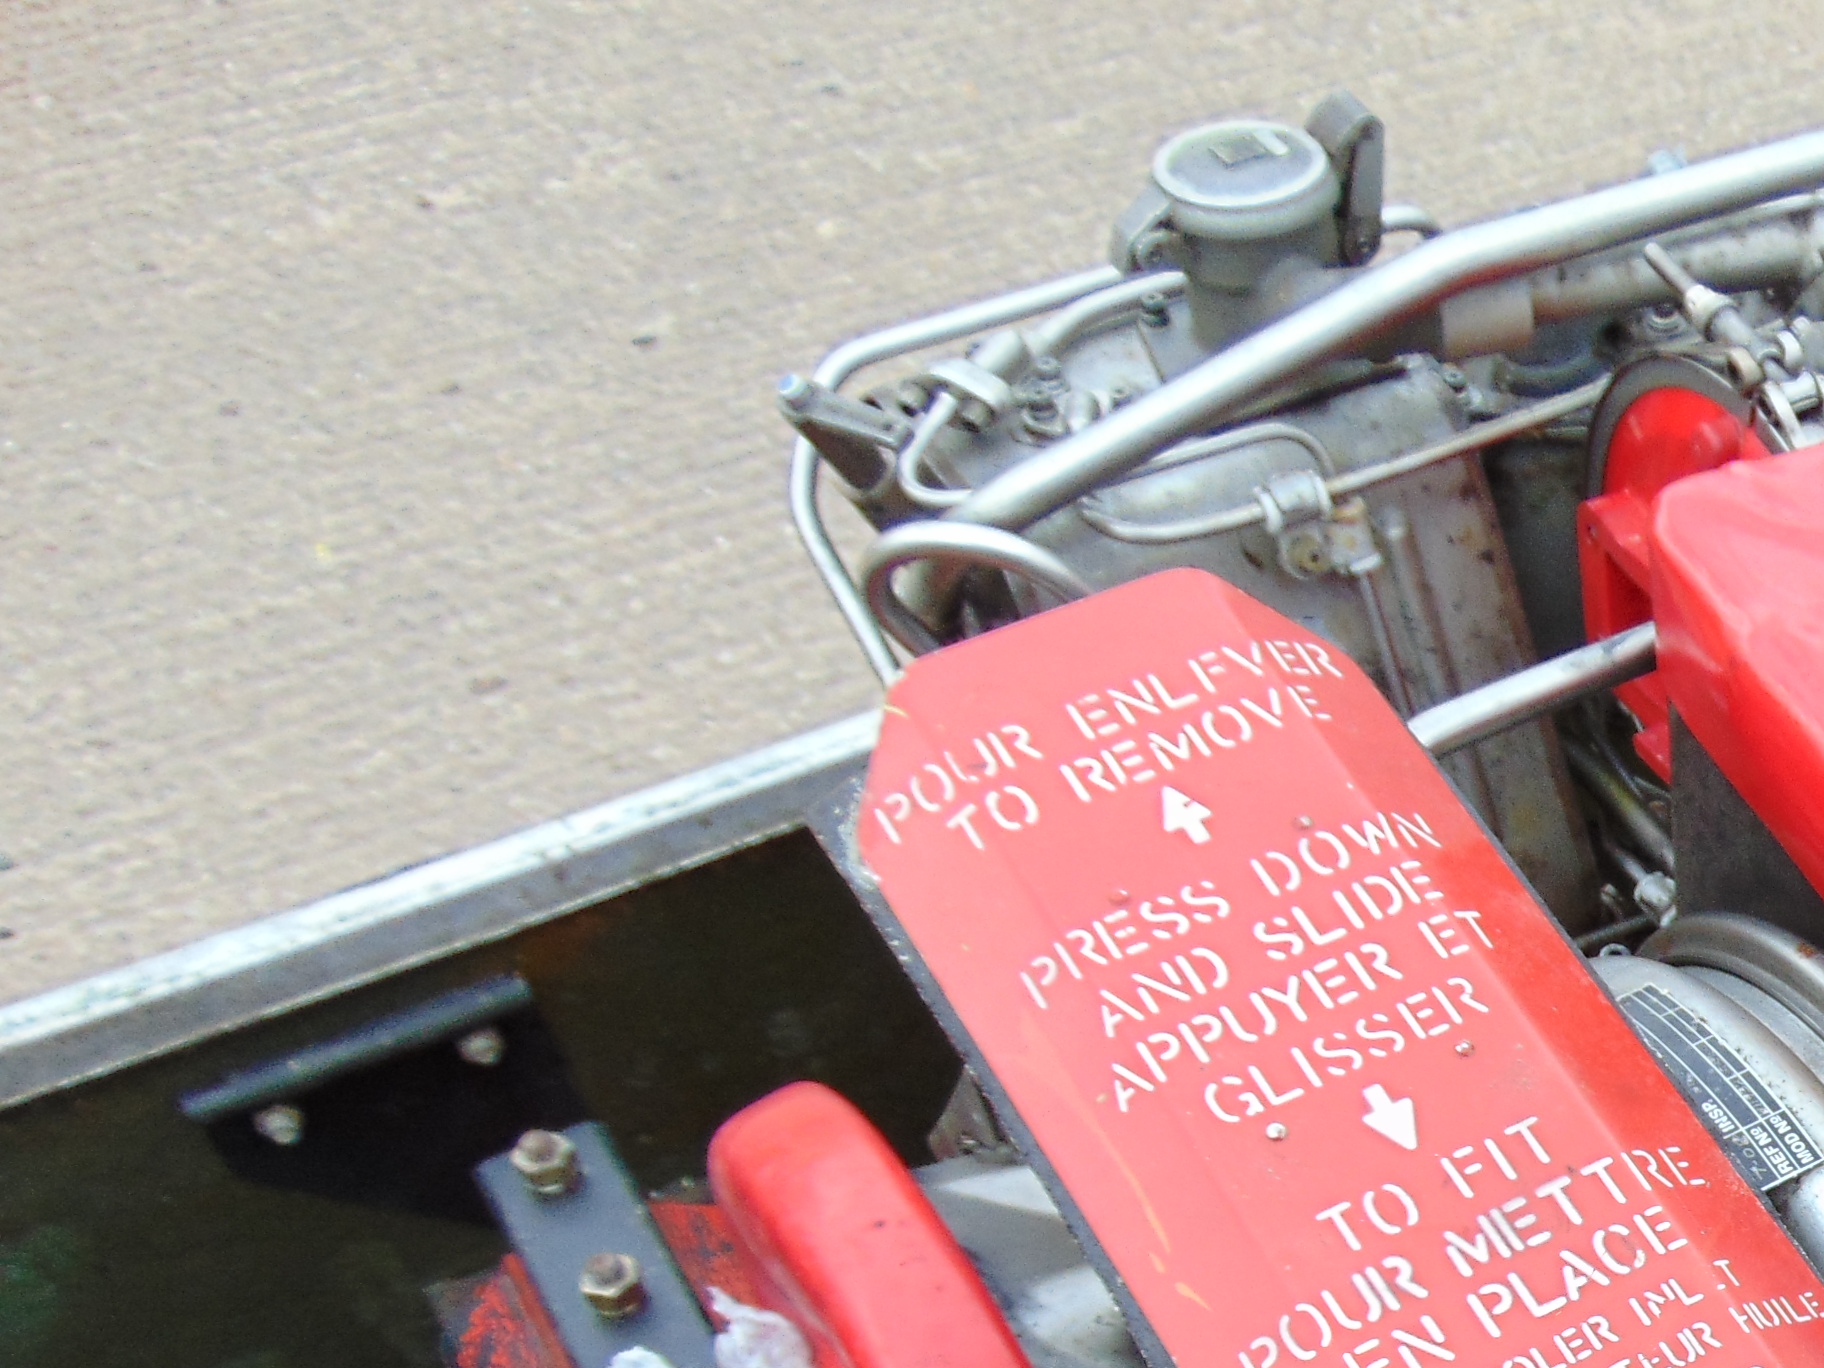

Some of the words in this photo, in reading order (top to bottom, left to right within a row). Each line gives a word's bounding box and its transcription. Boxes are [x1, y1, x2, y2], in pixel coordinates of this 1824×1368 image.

[873, 724, 1045, 845] POUR
[948, 785, 1040, 851] TO
[1060, 685, 1332, 803] REMOVE
[1020, 880, 1231, 1009] PRESS
[1250, 813, 1442, 896] DOWN
[1101, 947, 1229, 1038] AND
[1254, 860, 1444, 961] SLIDE
[1112, 943, 1404, 1112] APPUYER
[1418, 911, 1493, 959] ET
[1205, 977, 1490, 1123] GLISSER
[1317, 1184, 1420, 1251] TO
[1440, 1116, 1552, 1198] FIT
[1444, 1147, 1706, 1275] METTRE
[1766, 1144, 1793, 1176] REF
[1784, 1131, 1815, 1166] MOD
[1467, 1205, 1689, 1338] PLACE
[1630, 1260, 1740, 1326] INLT
